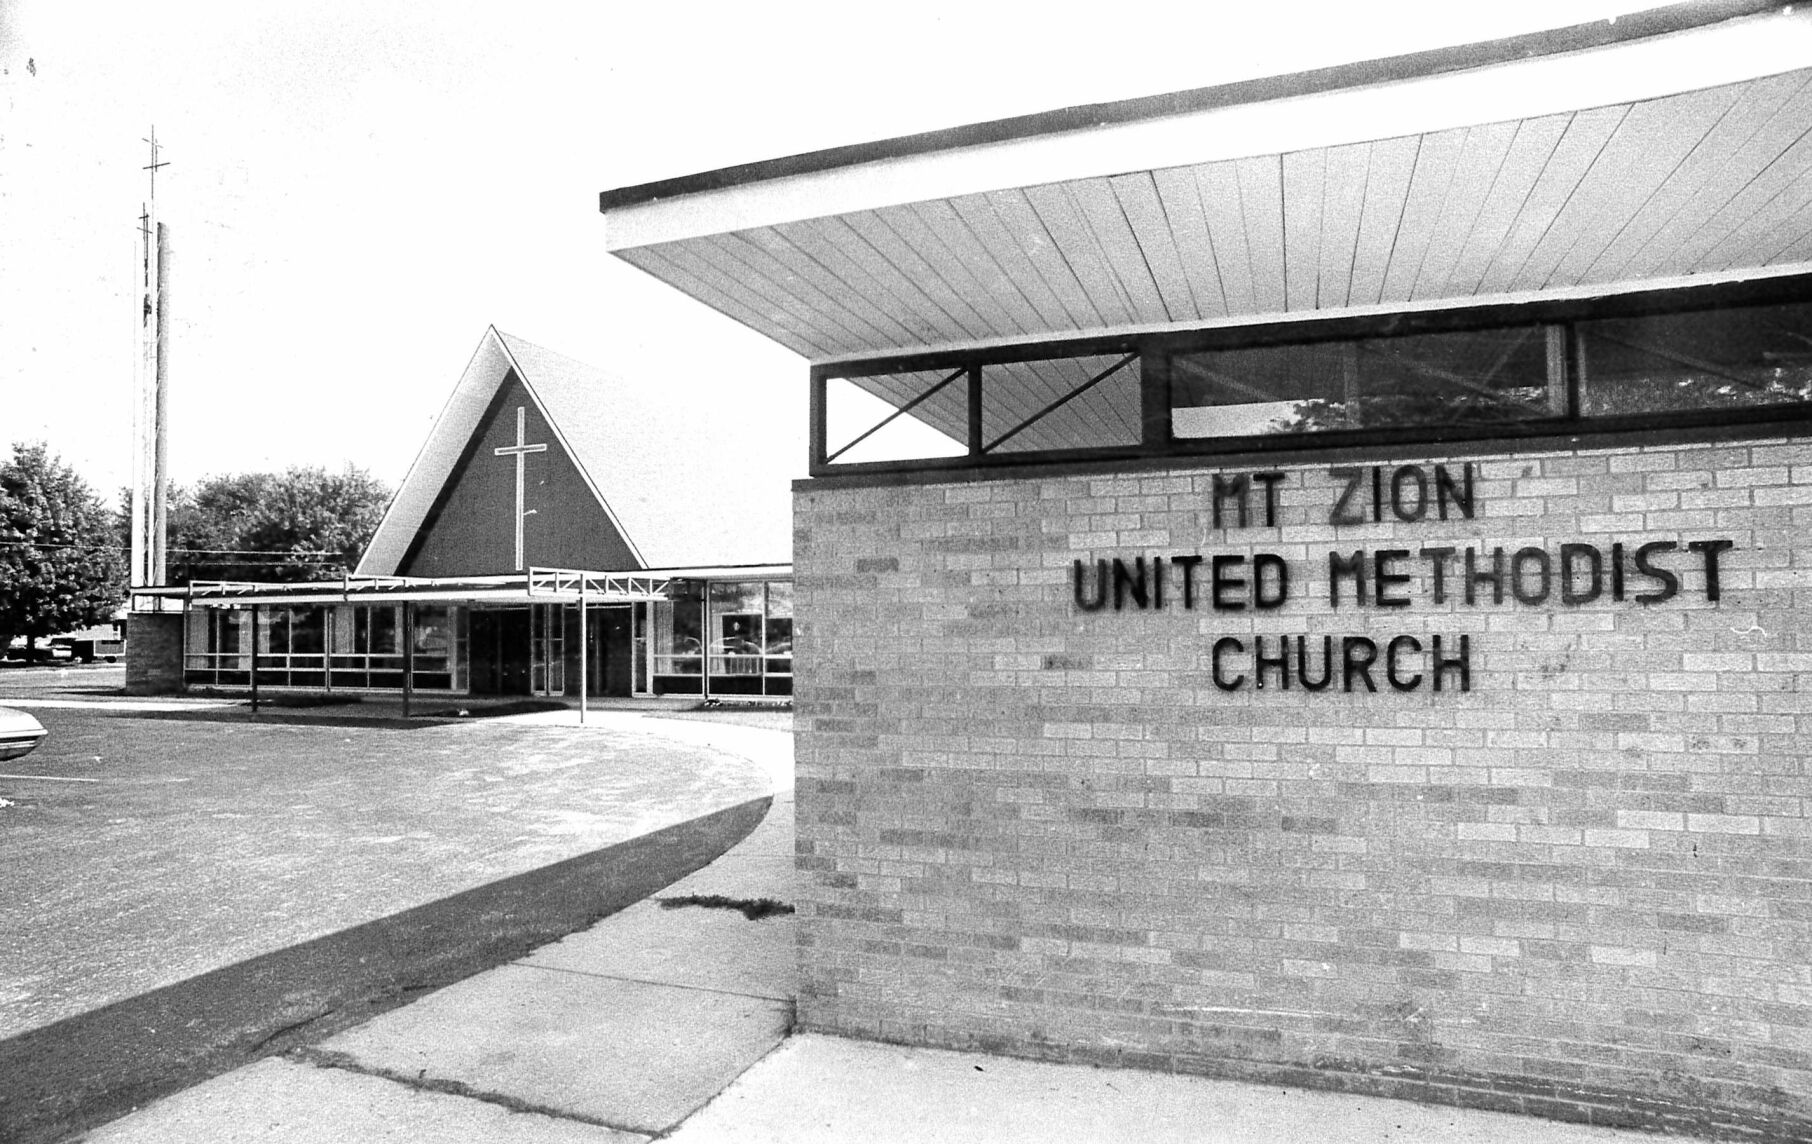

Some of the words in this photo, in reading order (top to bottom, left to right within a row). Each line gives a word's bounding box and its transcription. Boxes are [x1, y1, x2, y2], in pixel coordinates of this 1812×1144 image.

[1212, 471, 1285, 528] MT
[1329, 462, 1475, 525] ZION
[1073, 553, 1289, 612] UNITED
[1329, 540, 1733, 607] METHODIST
[1211, 634, 1471, 693] CHURCH
